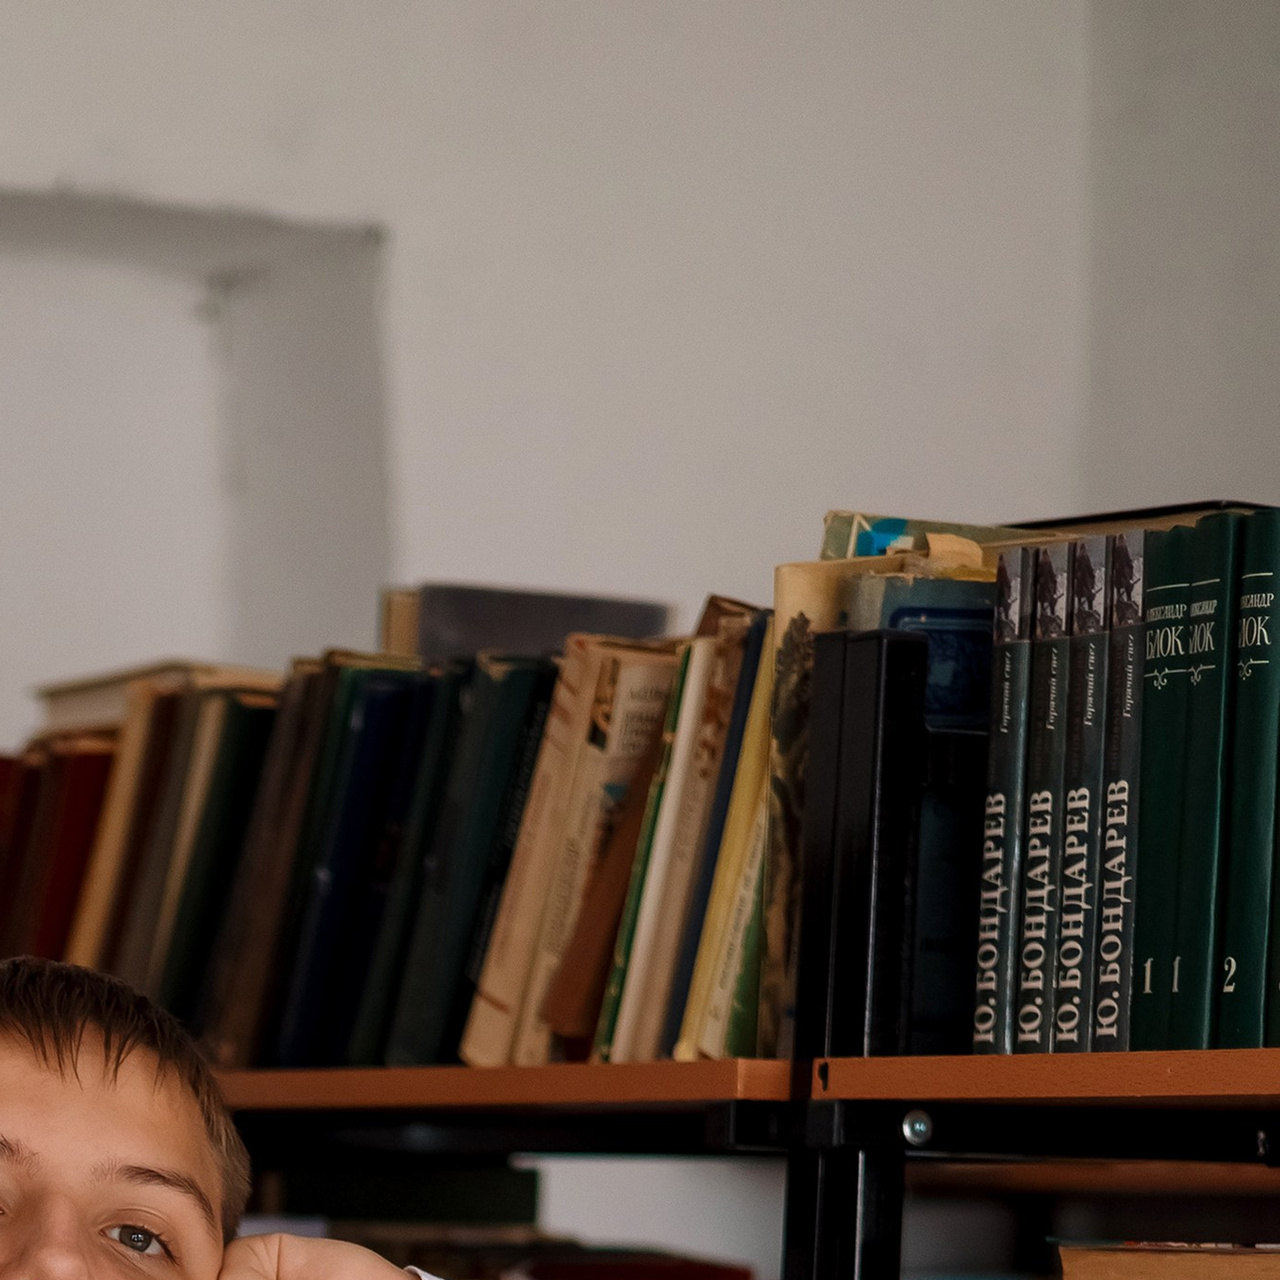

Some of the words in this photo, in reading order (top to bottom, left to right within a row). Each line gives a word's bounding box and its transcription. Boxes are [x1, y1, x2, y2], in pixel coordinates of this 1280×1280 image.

[1146, 626, 1185, 660] БЛОК
[1046, 678, 1058, 730] Горячий
[1083, 673, 1095, 726] Горячий
[1122, 664, 1134, 718] Горячий
[976, 793, 1009, 991] БОНДАРЕВ
[1021, 790, 1056, 991] БОНДАРЕВ
[1058, 787, 1094, 990] БОНДАРЕВ
[1099, 779, 1133, 985] БОНДАРЕВ
[1143, 957, 1154, 994] 1
[1172, 956, 1181, 992] 1
[1223, 956, 1236, 993] 2
[973, 998, 997, 1043] Ю.
[1018, 996, 1043, 1044] Ю.
[1056, 996, 1080, 1043] Ю.
[1096, 990, 1120, 1038] Ю.
